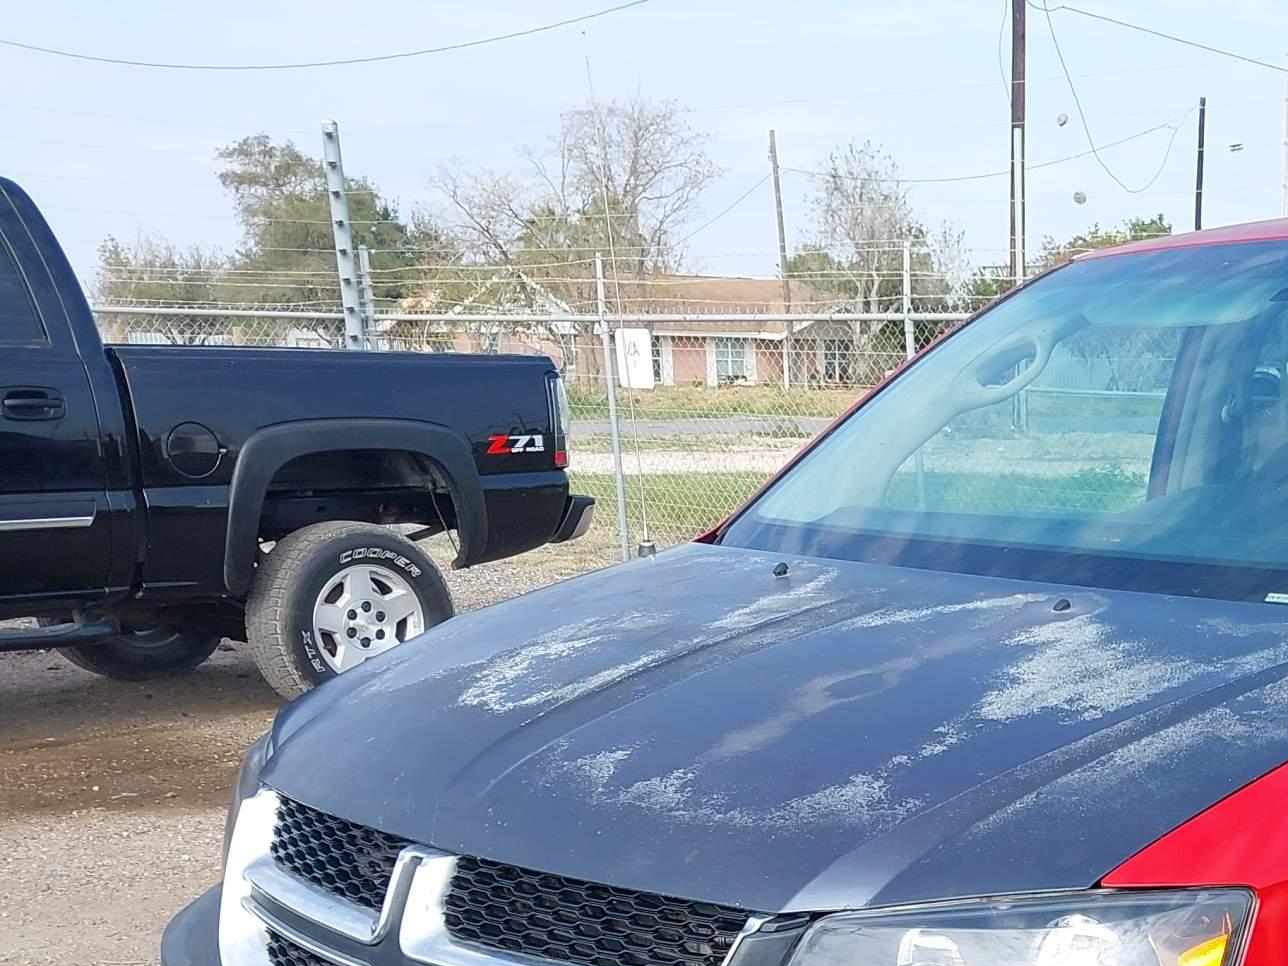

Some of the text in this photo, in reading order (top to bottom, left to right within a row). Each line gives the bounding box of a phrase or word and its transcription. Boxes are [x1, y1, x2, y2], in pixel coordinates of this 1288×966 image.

[487, 434, 544, 454] Z71
[339, 547, 423, 578] COOPER
[301, 630, 326, 673] RTX
